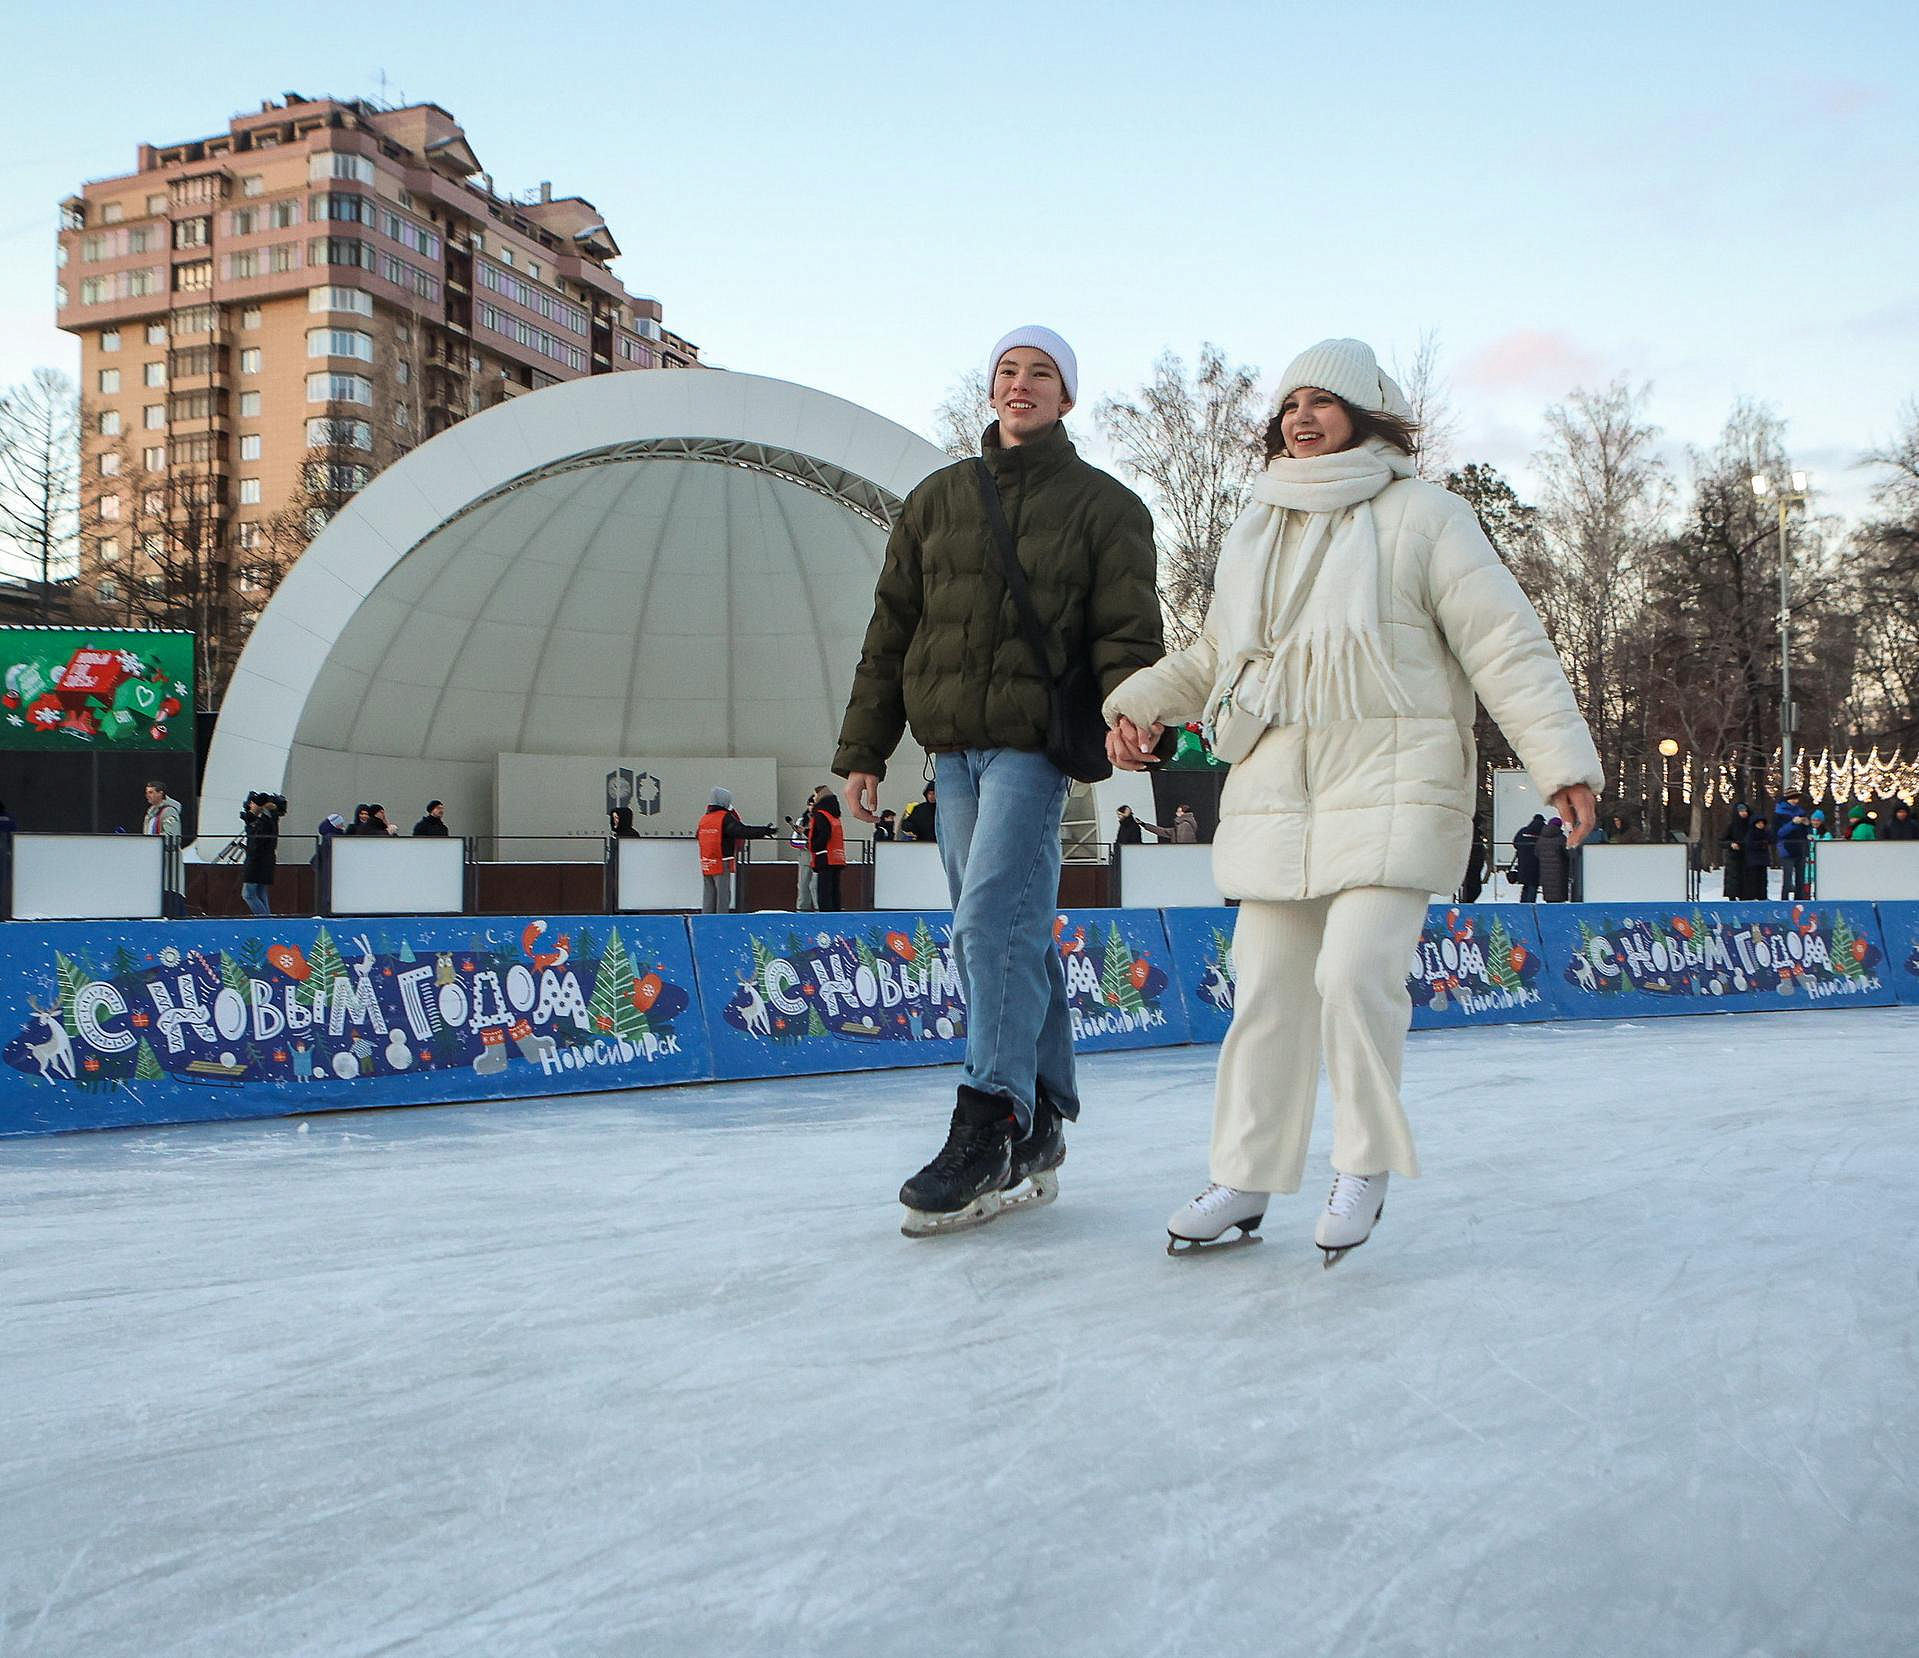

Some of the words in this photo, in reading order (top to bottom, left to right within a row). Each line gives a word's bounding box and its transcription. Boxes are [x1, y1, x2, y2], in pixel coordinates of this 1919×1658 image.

[1405, 937, 1491, 986] ОДОМ
[1589, 935, 1621, 977] С
[764, 958, 809, 1016] С
[74, 981, 137, 1053] С
